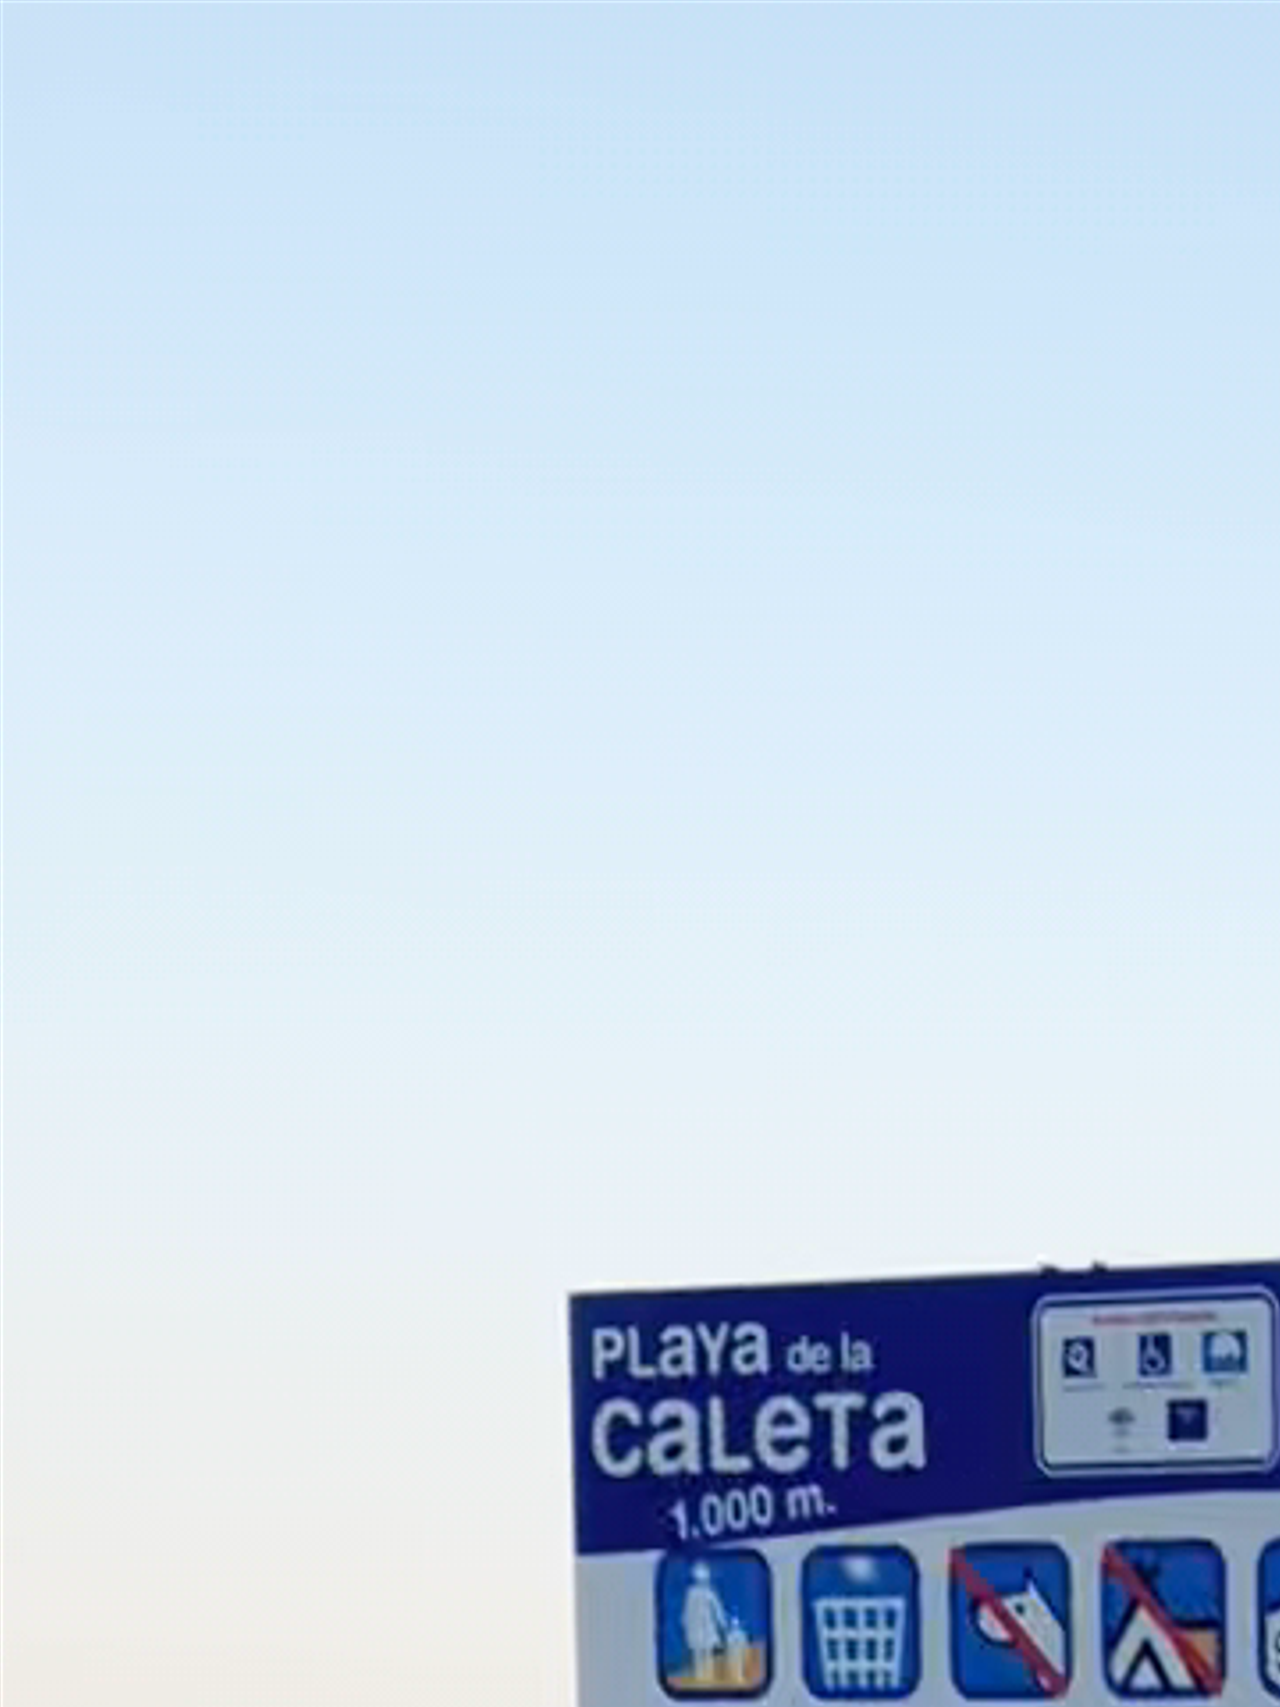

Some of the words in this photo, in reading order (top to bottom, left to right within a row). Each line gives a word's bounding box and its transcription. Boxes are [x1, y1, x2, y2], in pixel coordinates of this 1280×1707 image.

[786, 1335, 831, 1374] de
[839, 1331, 875, 1371] la
[669, 1484, 773, 1541] 1.000
[786, 1483, 837, 1519] m.
